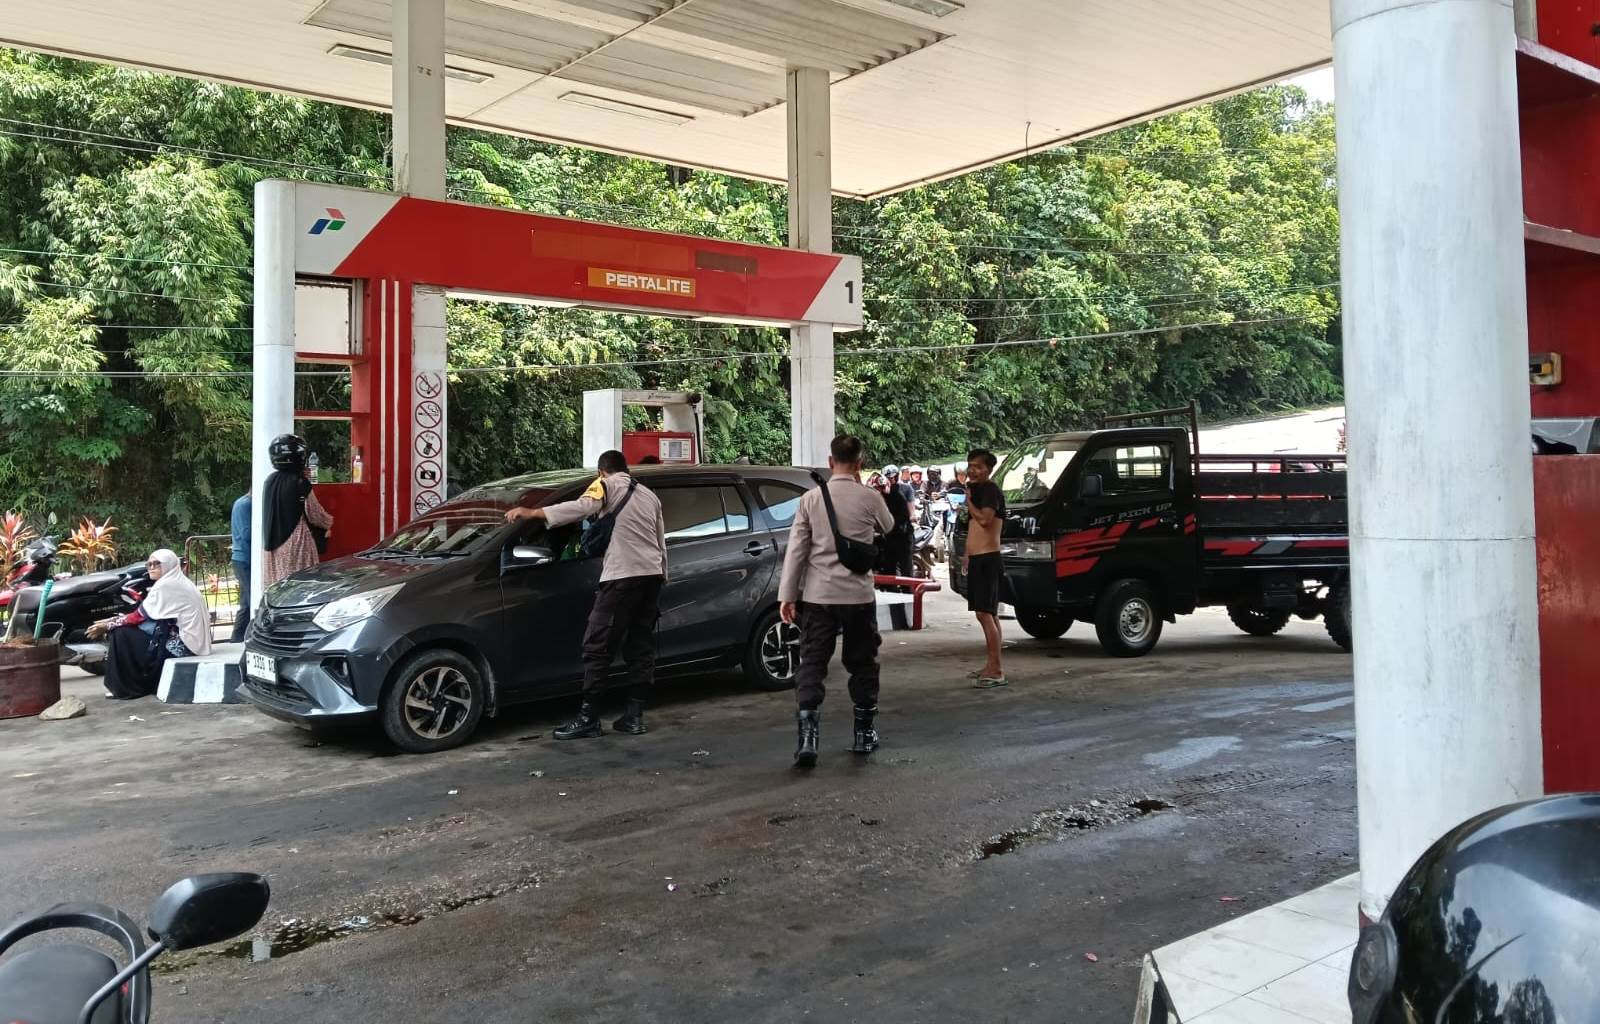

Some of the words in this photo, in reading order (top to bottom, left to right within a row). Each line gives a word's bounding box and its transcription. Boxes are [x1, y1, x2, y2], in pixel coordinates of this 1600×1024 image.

[605, 272, 691, 293] PERTALITE
[845, 280, 853, 304] 1
[1089, 514, 1114, 526] JET
[1118, 506, 1151, 519] PICK
[1156, 502, 1173, 512] UP
